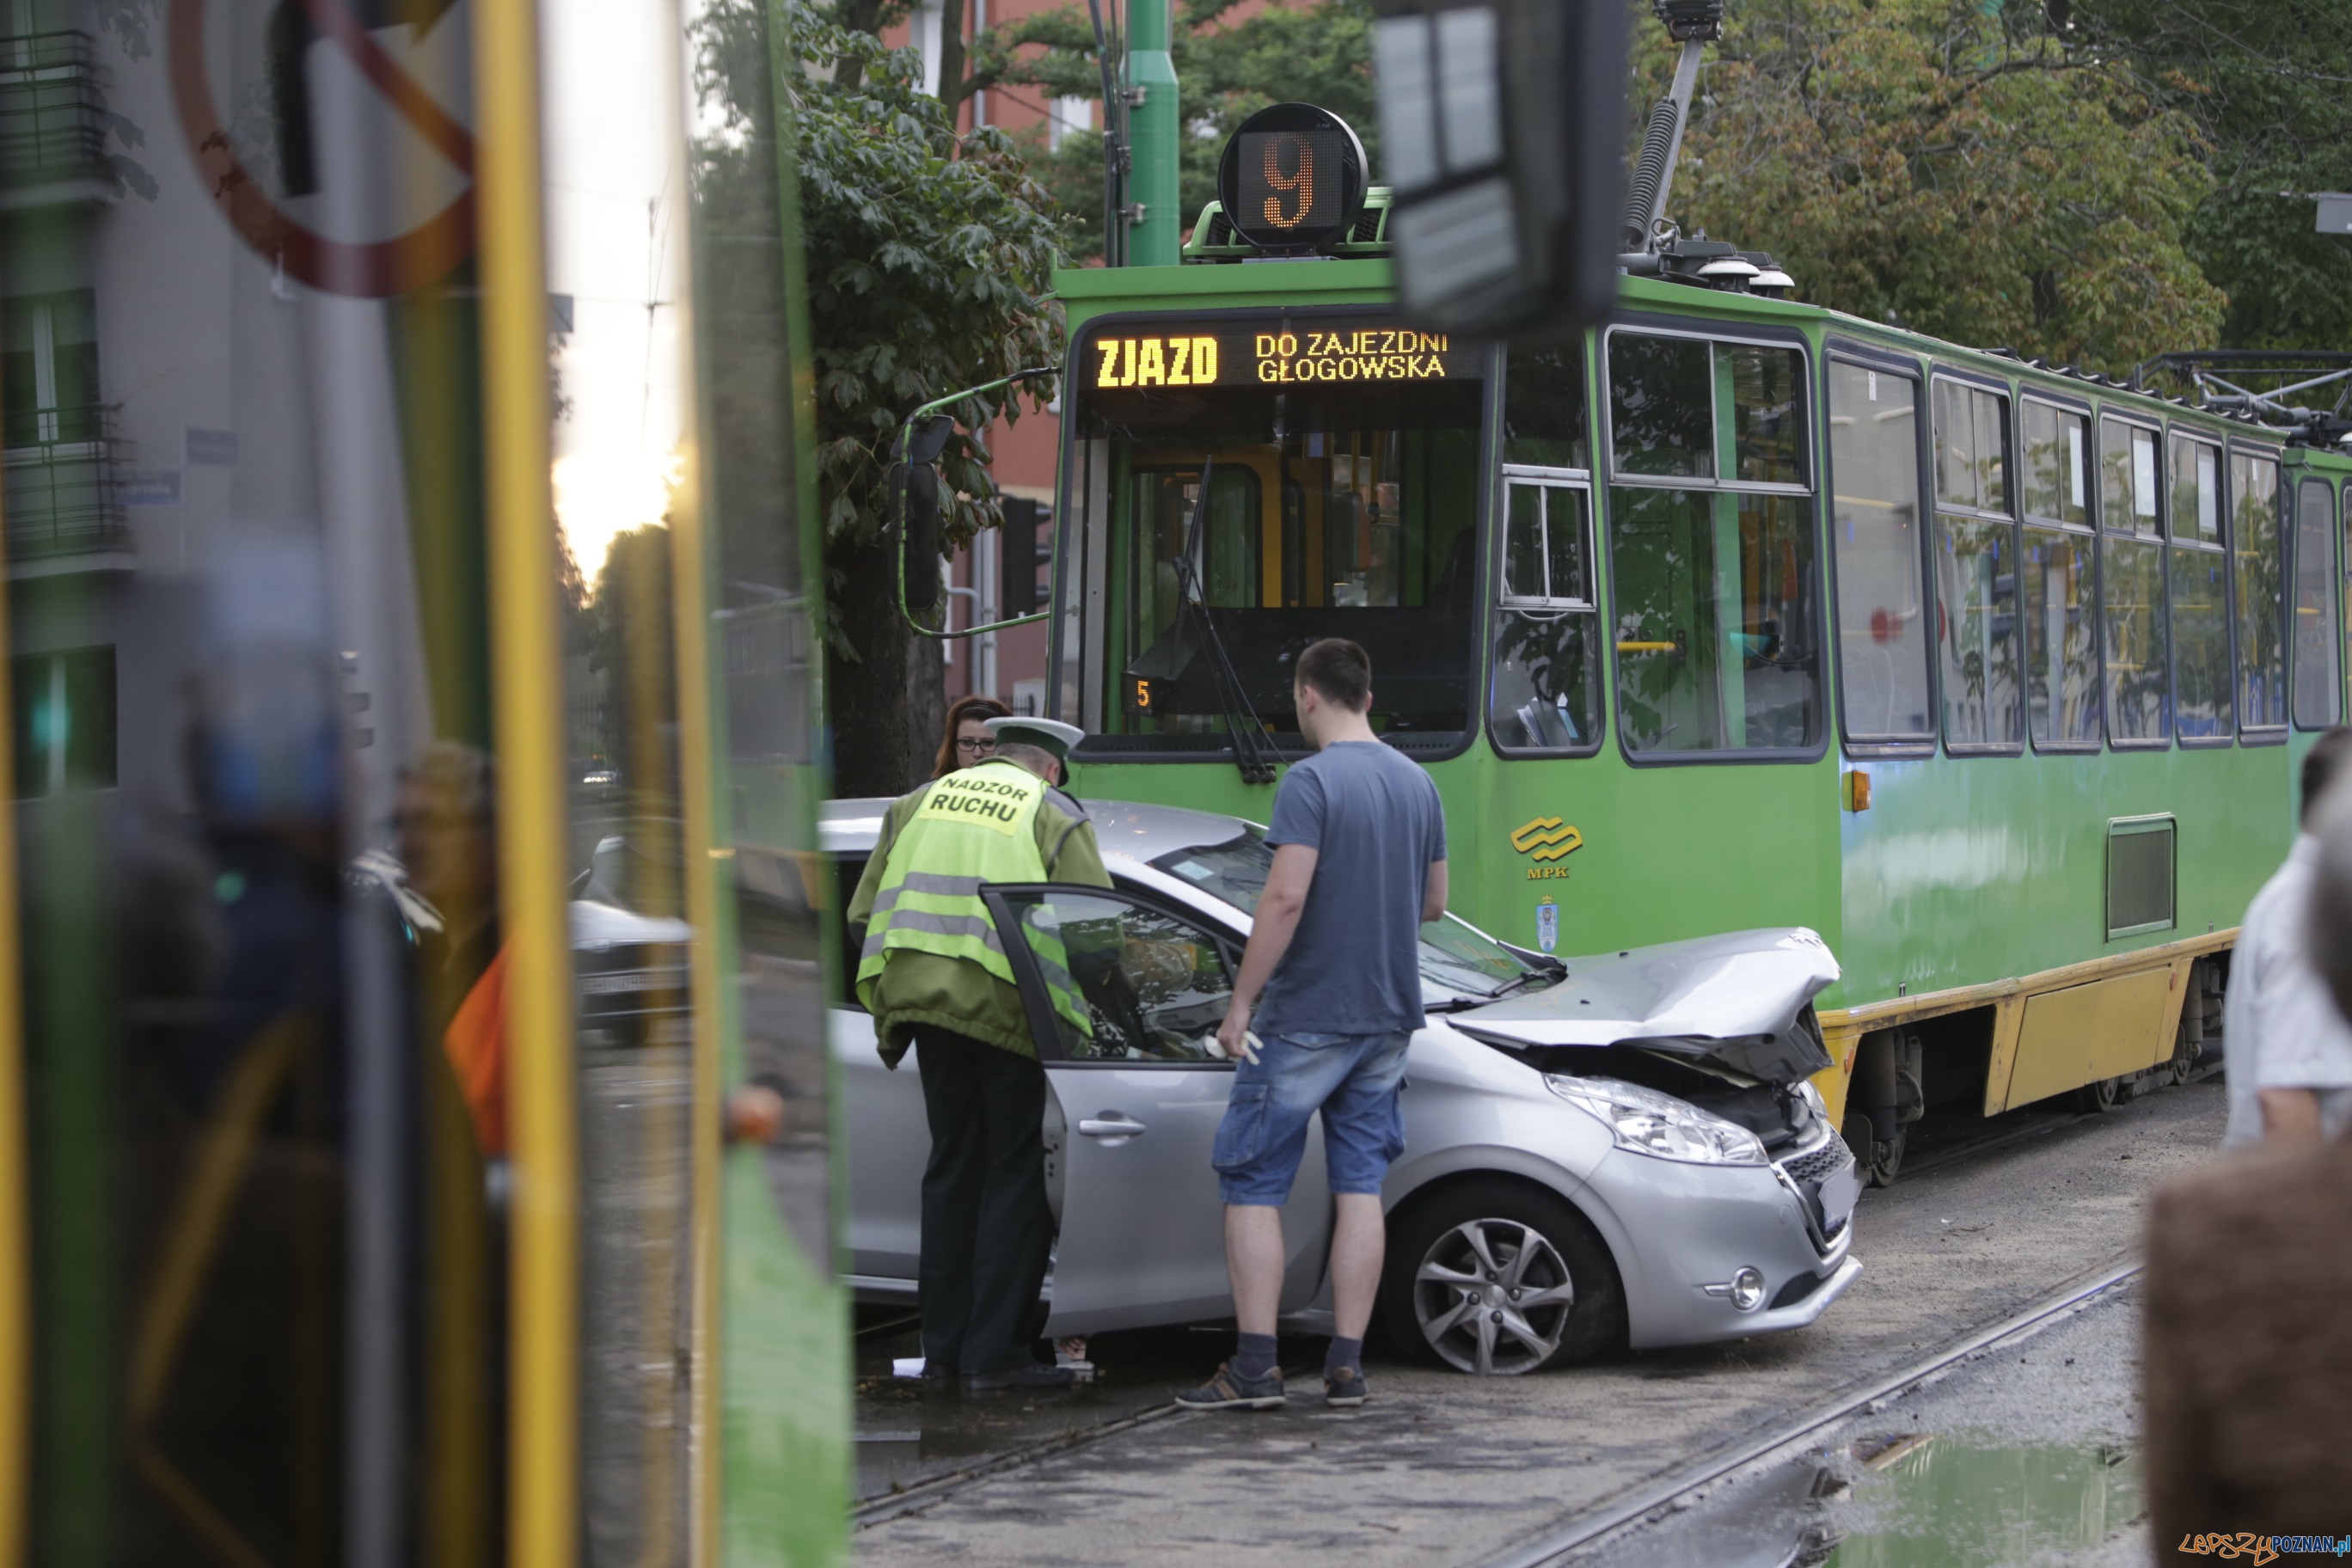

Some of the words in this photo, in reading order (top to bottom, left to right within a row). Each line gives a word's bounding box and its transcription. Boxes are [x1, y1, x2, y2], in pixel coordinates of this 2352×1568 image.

[1265, 132, 1313, 227] 9
[1256, 334, 1298, 358] DO
[1308, 331, 1448, 356] ZAJEZDNI
[1097, 336, 1218, 388] ZJAZD
[1258, 354, 1446, 383] GŁOGOWSKA
[1137, 680, 1149, 707] 5
[941, 777, 1030, 802] NADZÓR
[929, 793, 1017, 823] RUCHU
[1526, 867, 1570, 880] MPK
